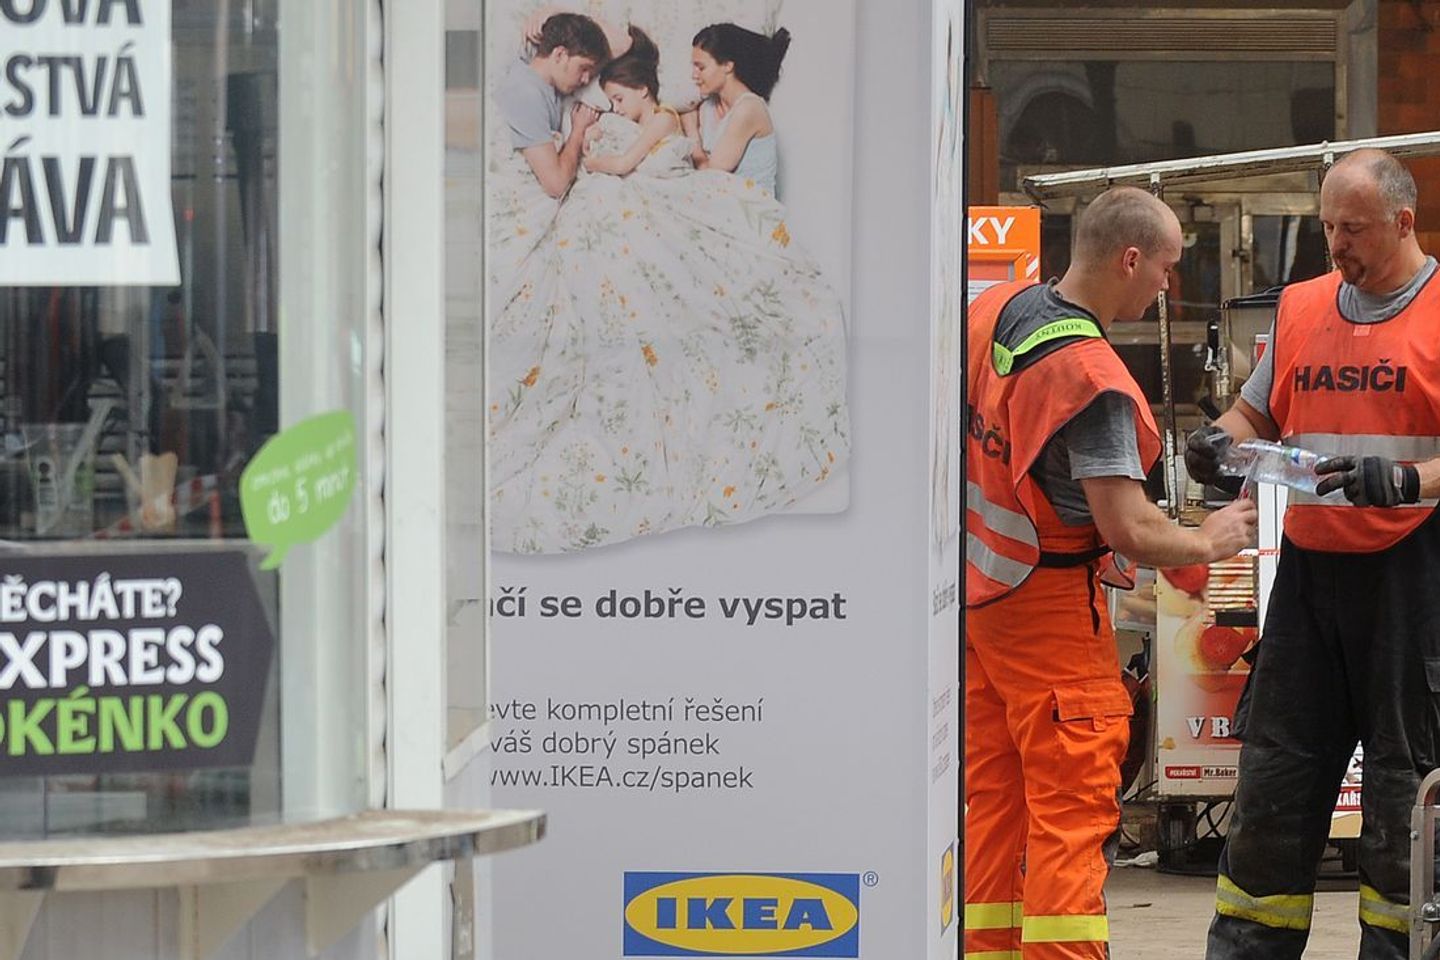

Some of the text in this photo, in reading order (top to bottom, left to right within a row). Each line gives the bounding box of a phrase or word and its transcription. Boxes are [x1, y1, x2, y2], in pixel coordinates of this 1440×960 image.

[0, 41, 147, 118] STVÁ
[1294, 358, 1408, 392] HASIČI
[490, 586, 847, 626] čí se dobře vyspat
[0, 624, 225, 689] XPRESS
[0, 685, 229, 756] KÉNKO
[547, 697, 674, 726] kompletní
[685, 697, 763, 721] řešení
[491, 729, 720, 759] váš dobrý spánek
[656, 896, 835, 931] IKEA
